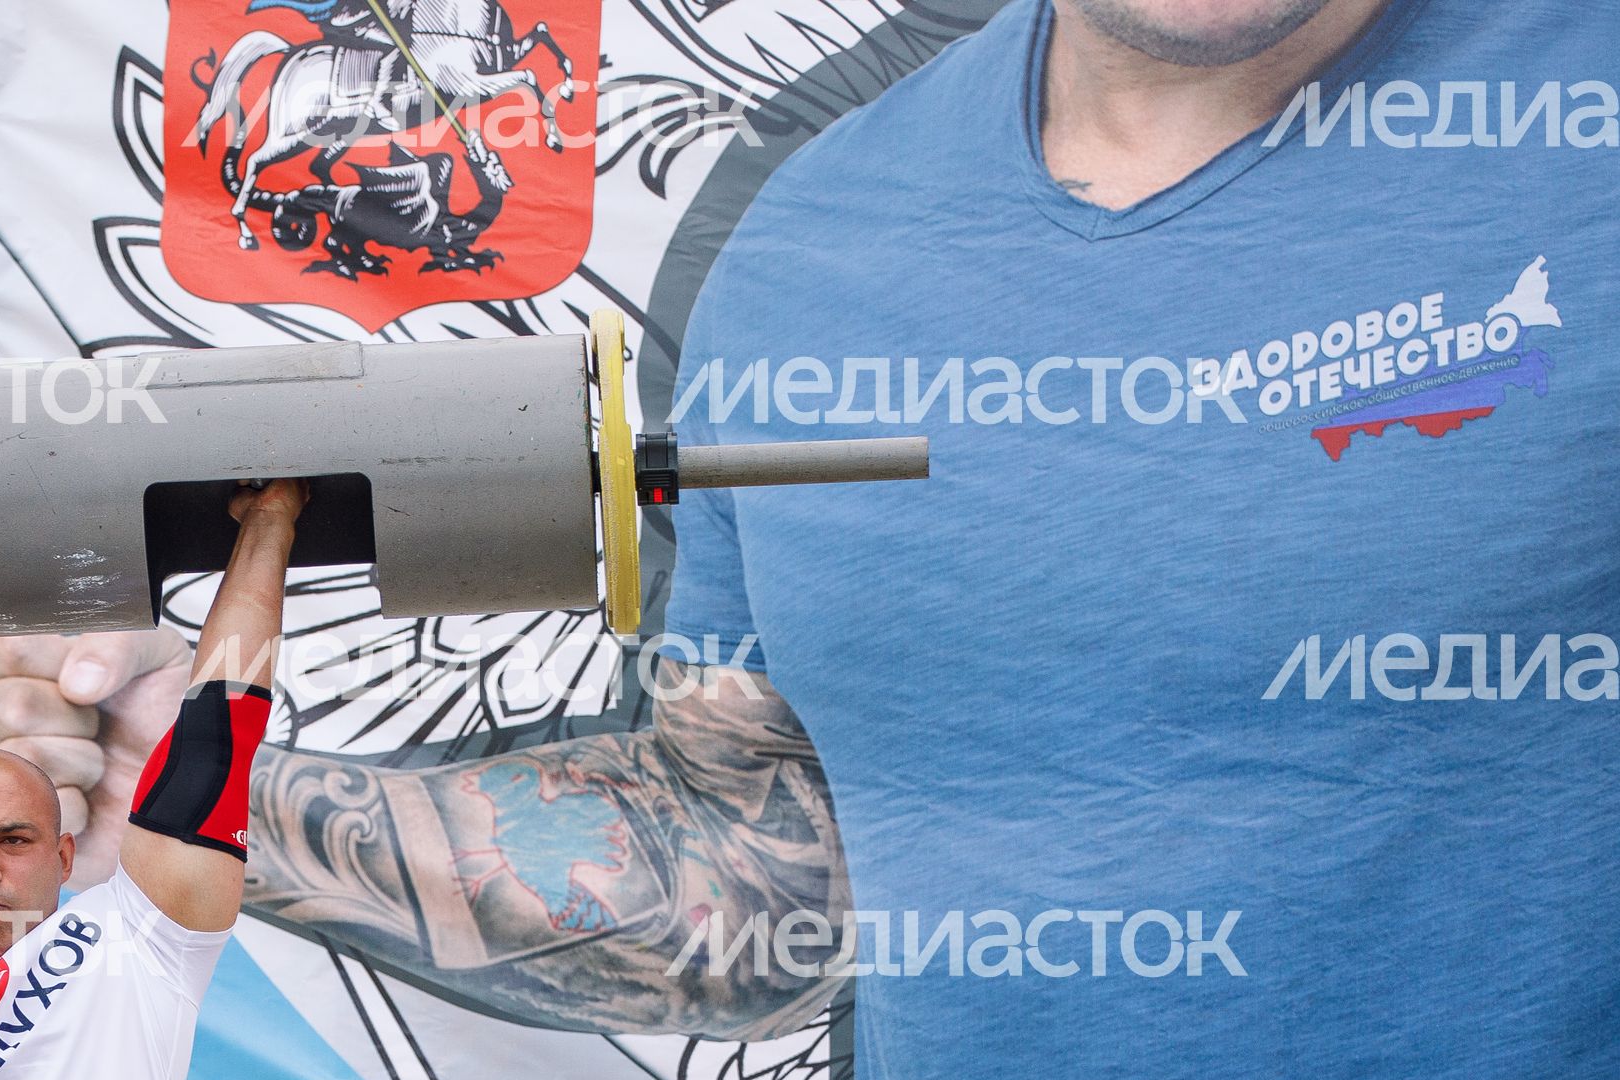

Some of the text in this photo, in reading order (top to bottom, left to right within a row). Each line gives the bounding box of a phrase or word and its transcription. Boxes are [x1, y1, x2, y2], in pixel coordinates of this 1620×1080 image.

[1193, 291, 1444, 397] ЗДОРОВОЕ
[1258, 316, 1519, 416] ОТЕЧЕСТВО
[1456, 356, 1519, 382] движение
